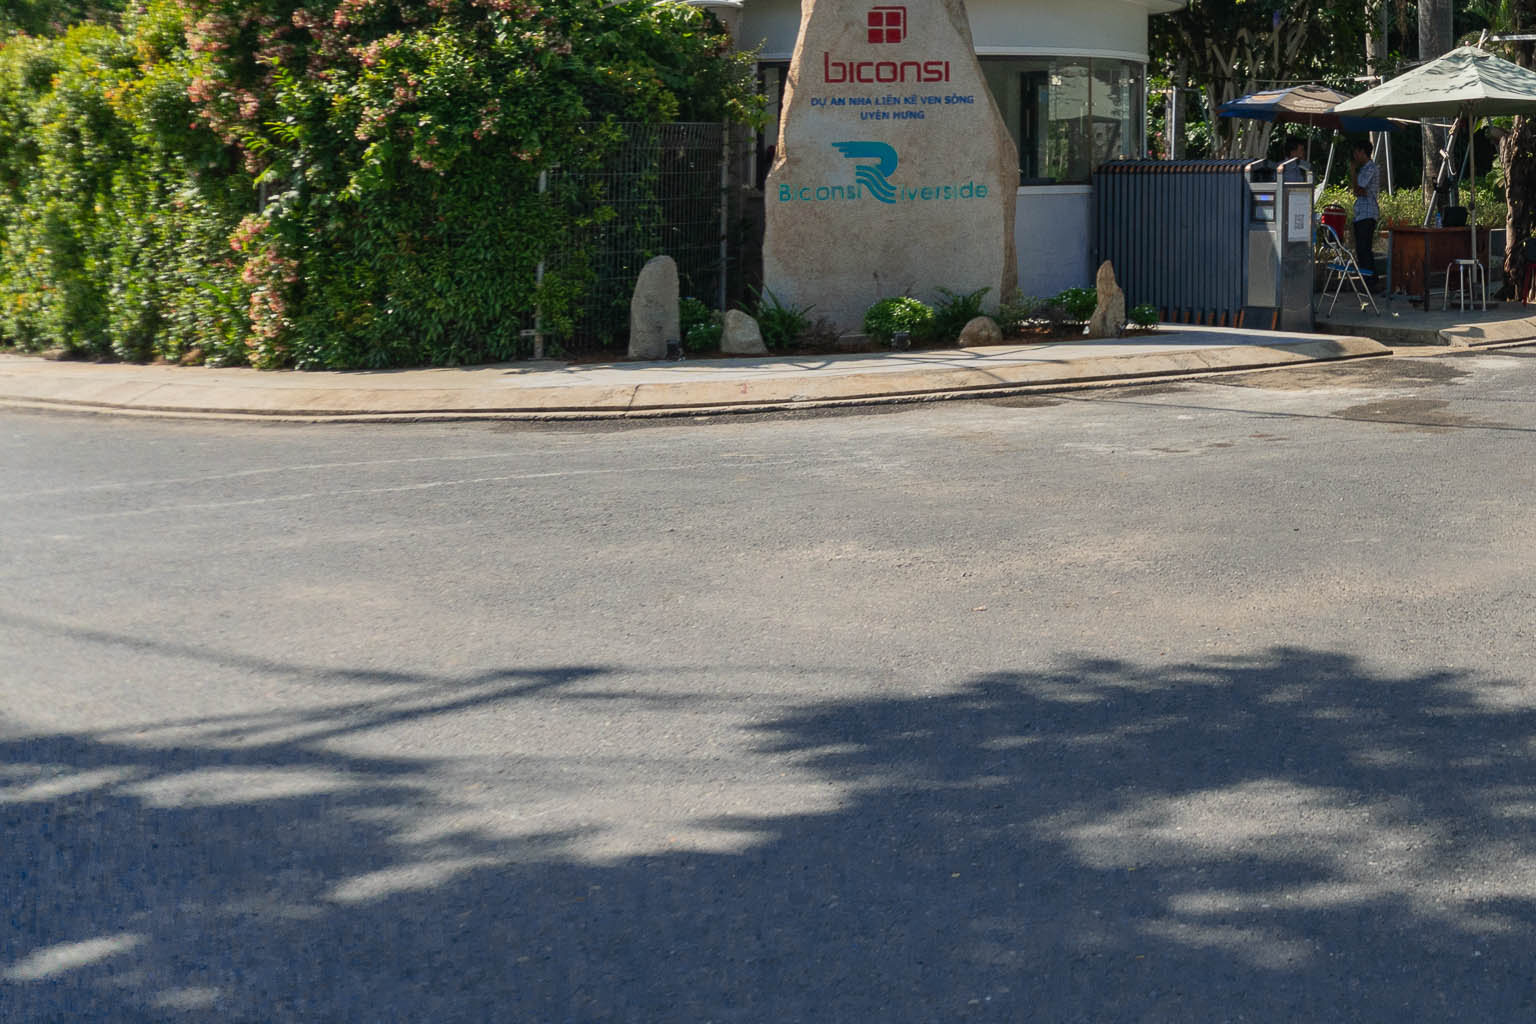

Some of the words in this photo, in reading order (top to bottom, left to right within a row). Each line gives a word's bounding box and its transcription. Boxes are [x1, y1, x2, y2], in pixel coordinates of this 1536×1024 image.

[824, 51, 950, 83] biconsi
[920, 95, 942, 105] VEN
[778, 183, 862, 202] Biconsi
